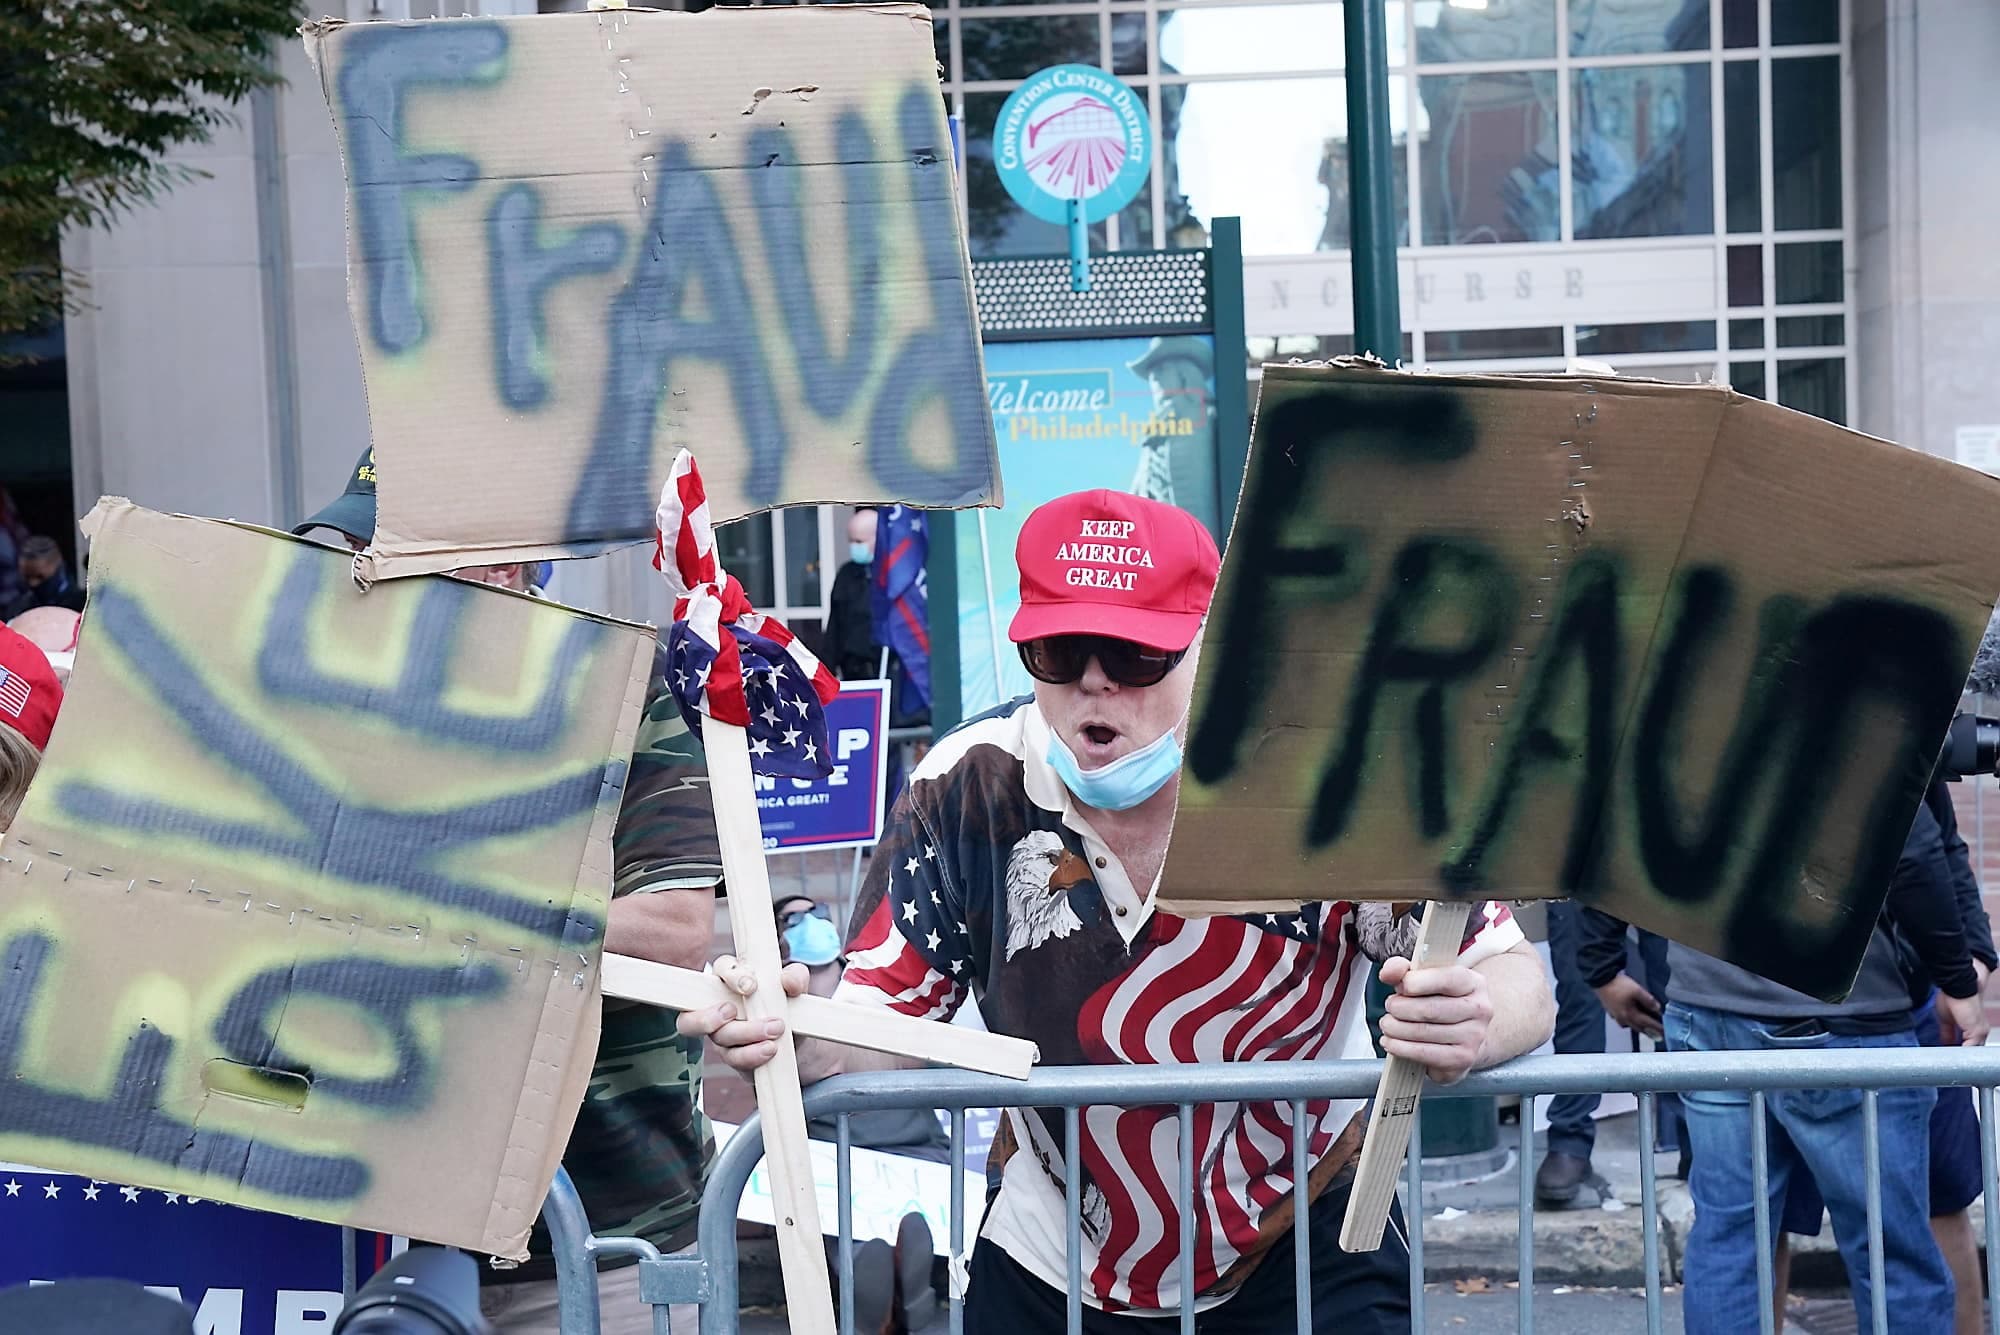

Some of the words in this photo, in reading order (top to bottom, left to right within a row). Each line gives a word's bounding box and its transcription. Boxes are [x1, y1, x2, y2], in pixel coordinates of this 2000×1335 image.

[1011, 411, 1193, 443] Philadelphia
[1080, 519, 1136, 539] KEEP
[1055, 543, 1155, 568] AMERICA
[1065, 567, 1138, 591] GREAT
[1187, 388, 1968, 1003] FRAUD
[757, 797, 784, 808] RICA
